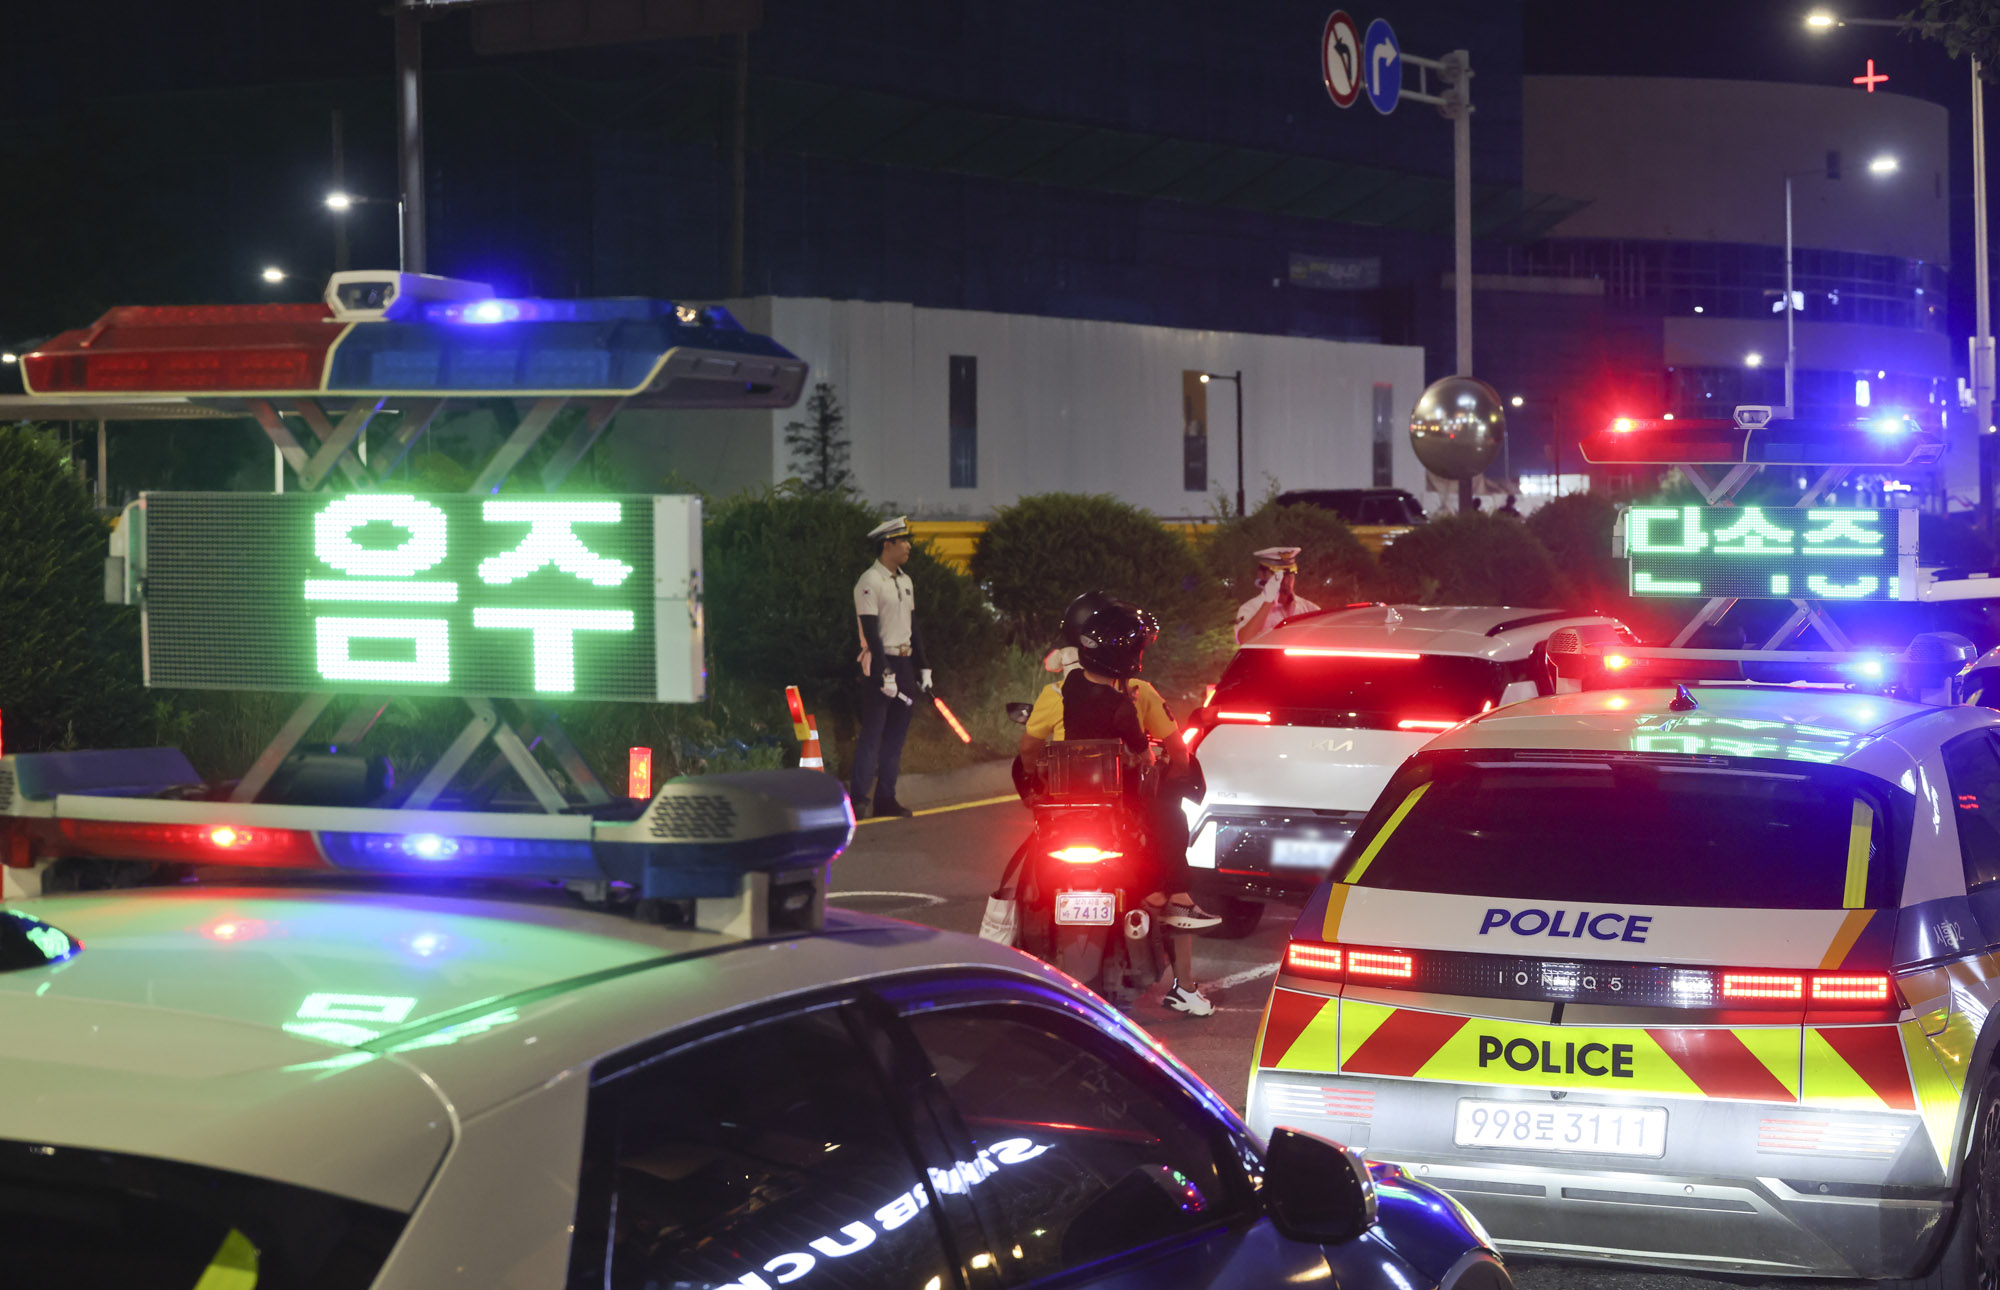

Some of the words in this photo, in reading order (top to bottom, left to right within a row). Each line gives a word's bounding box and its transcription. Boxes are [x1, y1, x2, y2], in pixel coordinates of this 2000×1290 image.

[303, 493, 635, 693] 음주
[1073, 906, 1109, 919] 7413
[1478, 908, 1653, 944] POLICE
[1609, 977, 1622, 991] 5
[1478, 1035, 1634, 1078] POLICE
